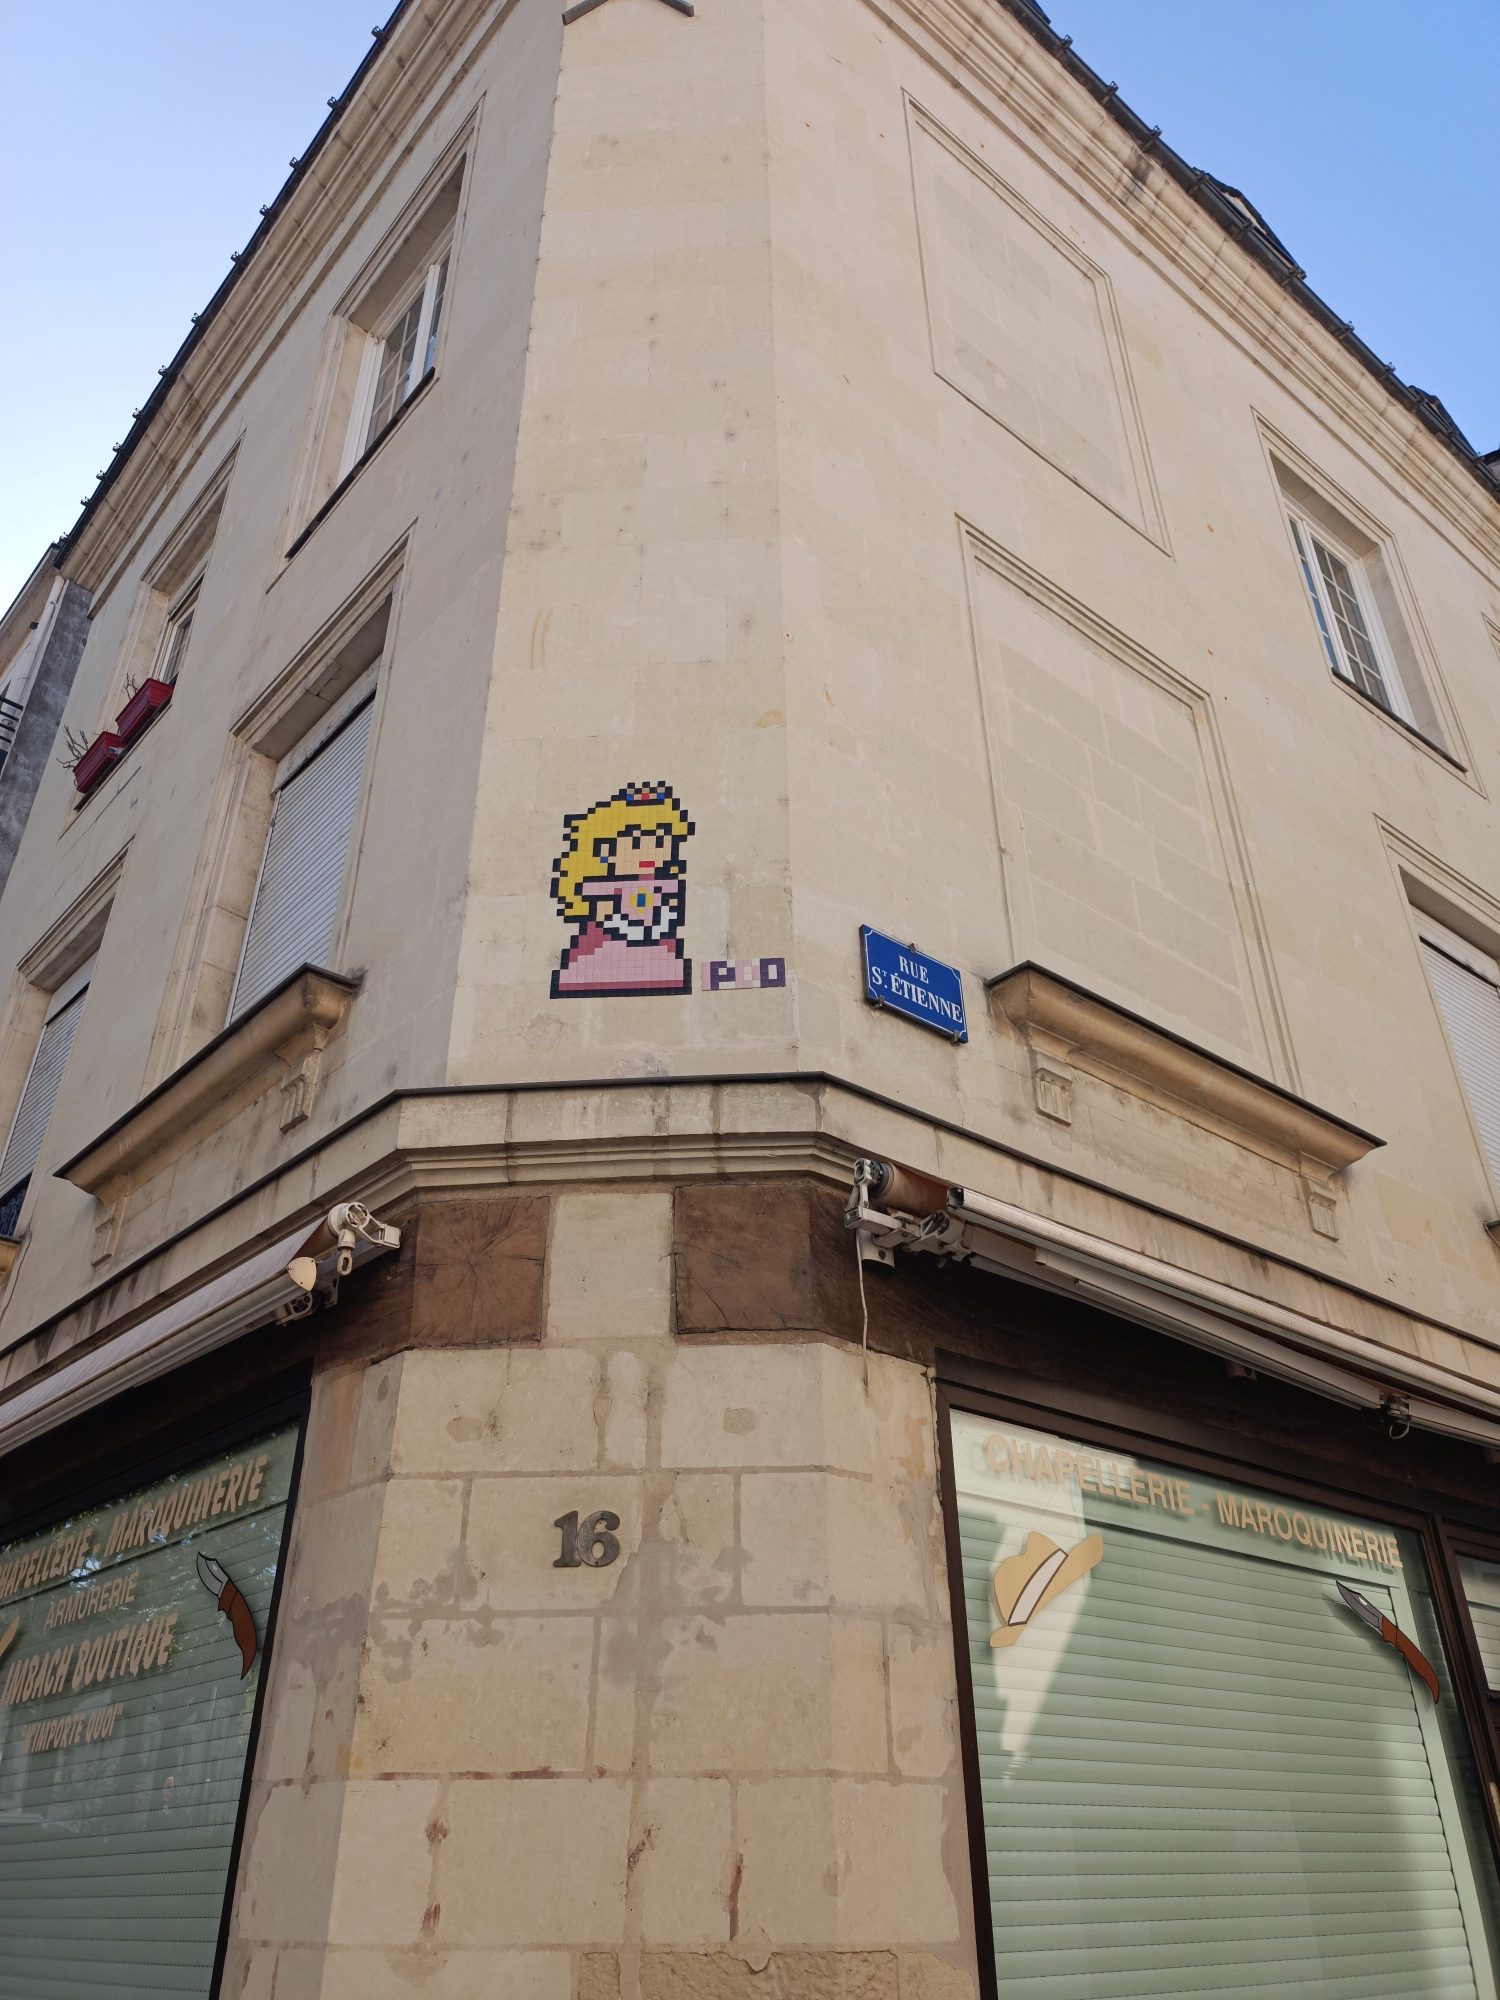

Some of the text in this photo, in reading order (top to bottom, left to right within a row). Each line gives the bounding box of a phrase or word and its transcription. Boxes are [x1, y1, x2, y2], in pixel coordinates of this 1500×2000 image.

[890, 972, 963, 1023] ÉTIENNE
[898, 955, 929, 984] RUE
[0, 1527, 95, 1599] HAPELLERIE
[104, 1455, 268, 1556] MAROQUINERIE
[984, 1434, 1195, 1515] CHAPELLERIE
[1215, 1489, 1403, 1568] MAROQUINERIE
[553, 1510, 620, 1567] 16
[44, 1567, 140, 1630] ARMURERIE
[71, 1612, 178, 1690] BOUTIQUE
